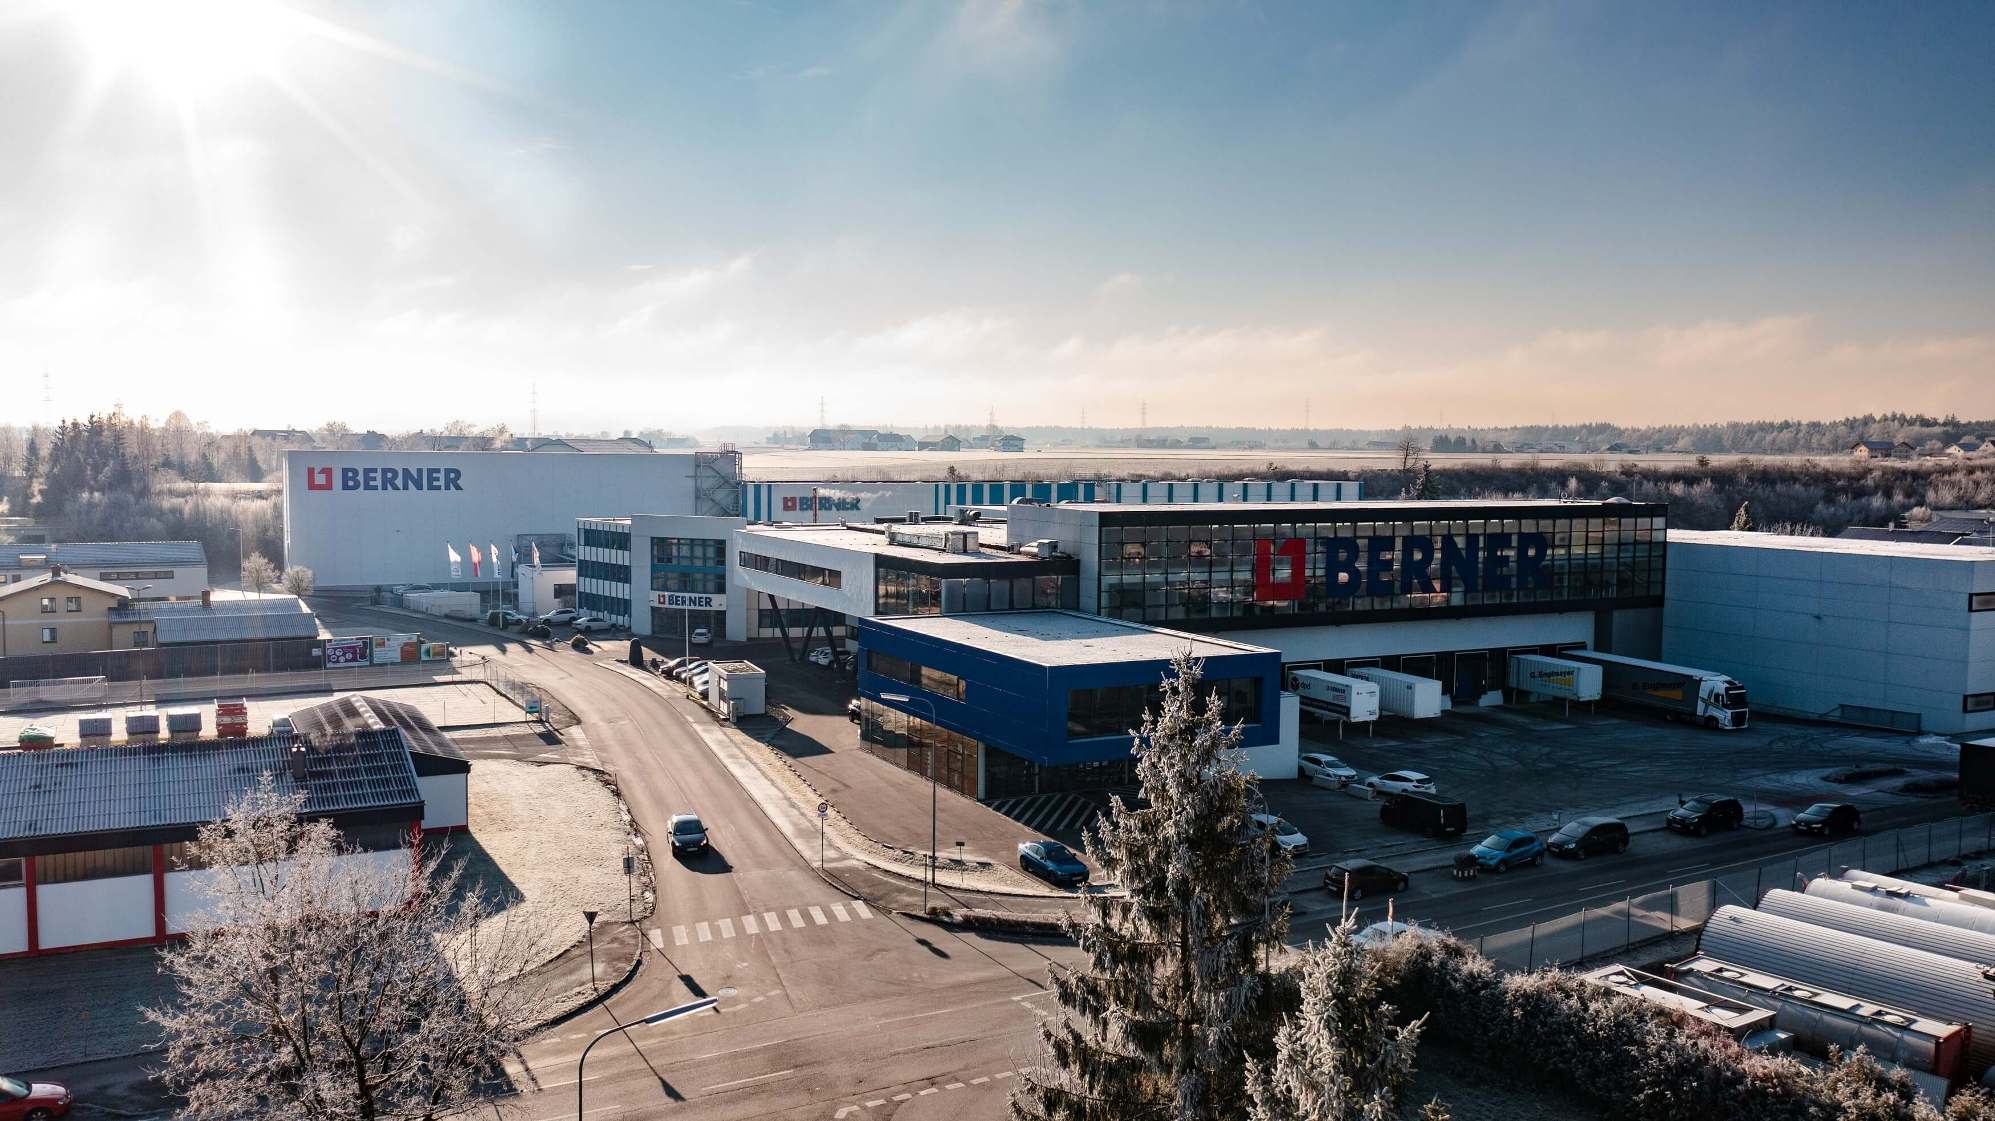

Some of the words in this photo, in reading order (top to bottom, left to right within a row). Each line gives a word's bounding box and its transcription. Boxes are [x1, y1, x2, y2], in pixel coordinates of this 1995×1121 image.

[342, 467, 463, 491] BERNER
[1326, 533, 1548, 598] BERNER
[668, 594, 713, 608] BERNER
[1301, 679, 1311, 690] dpd
